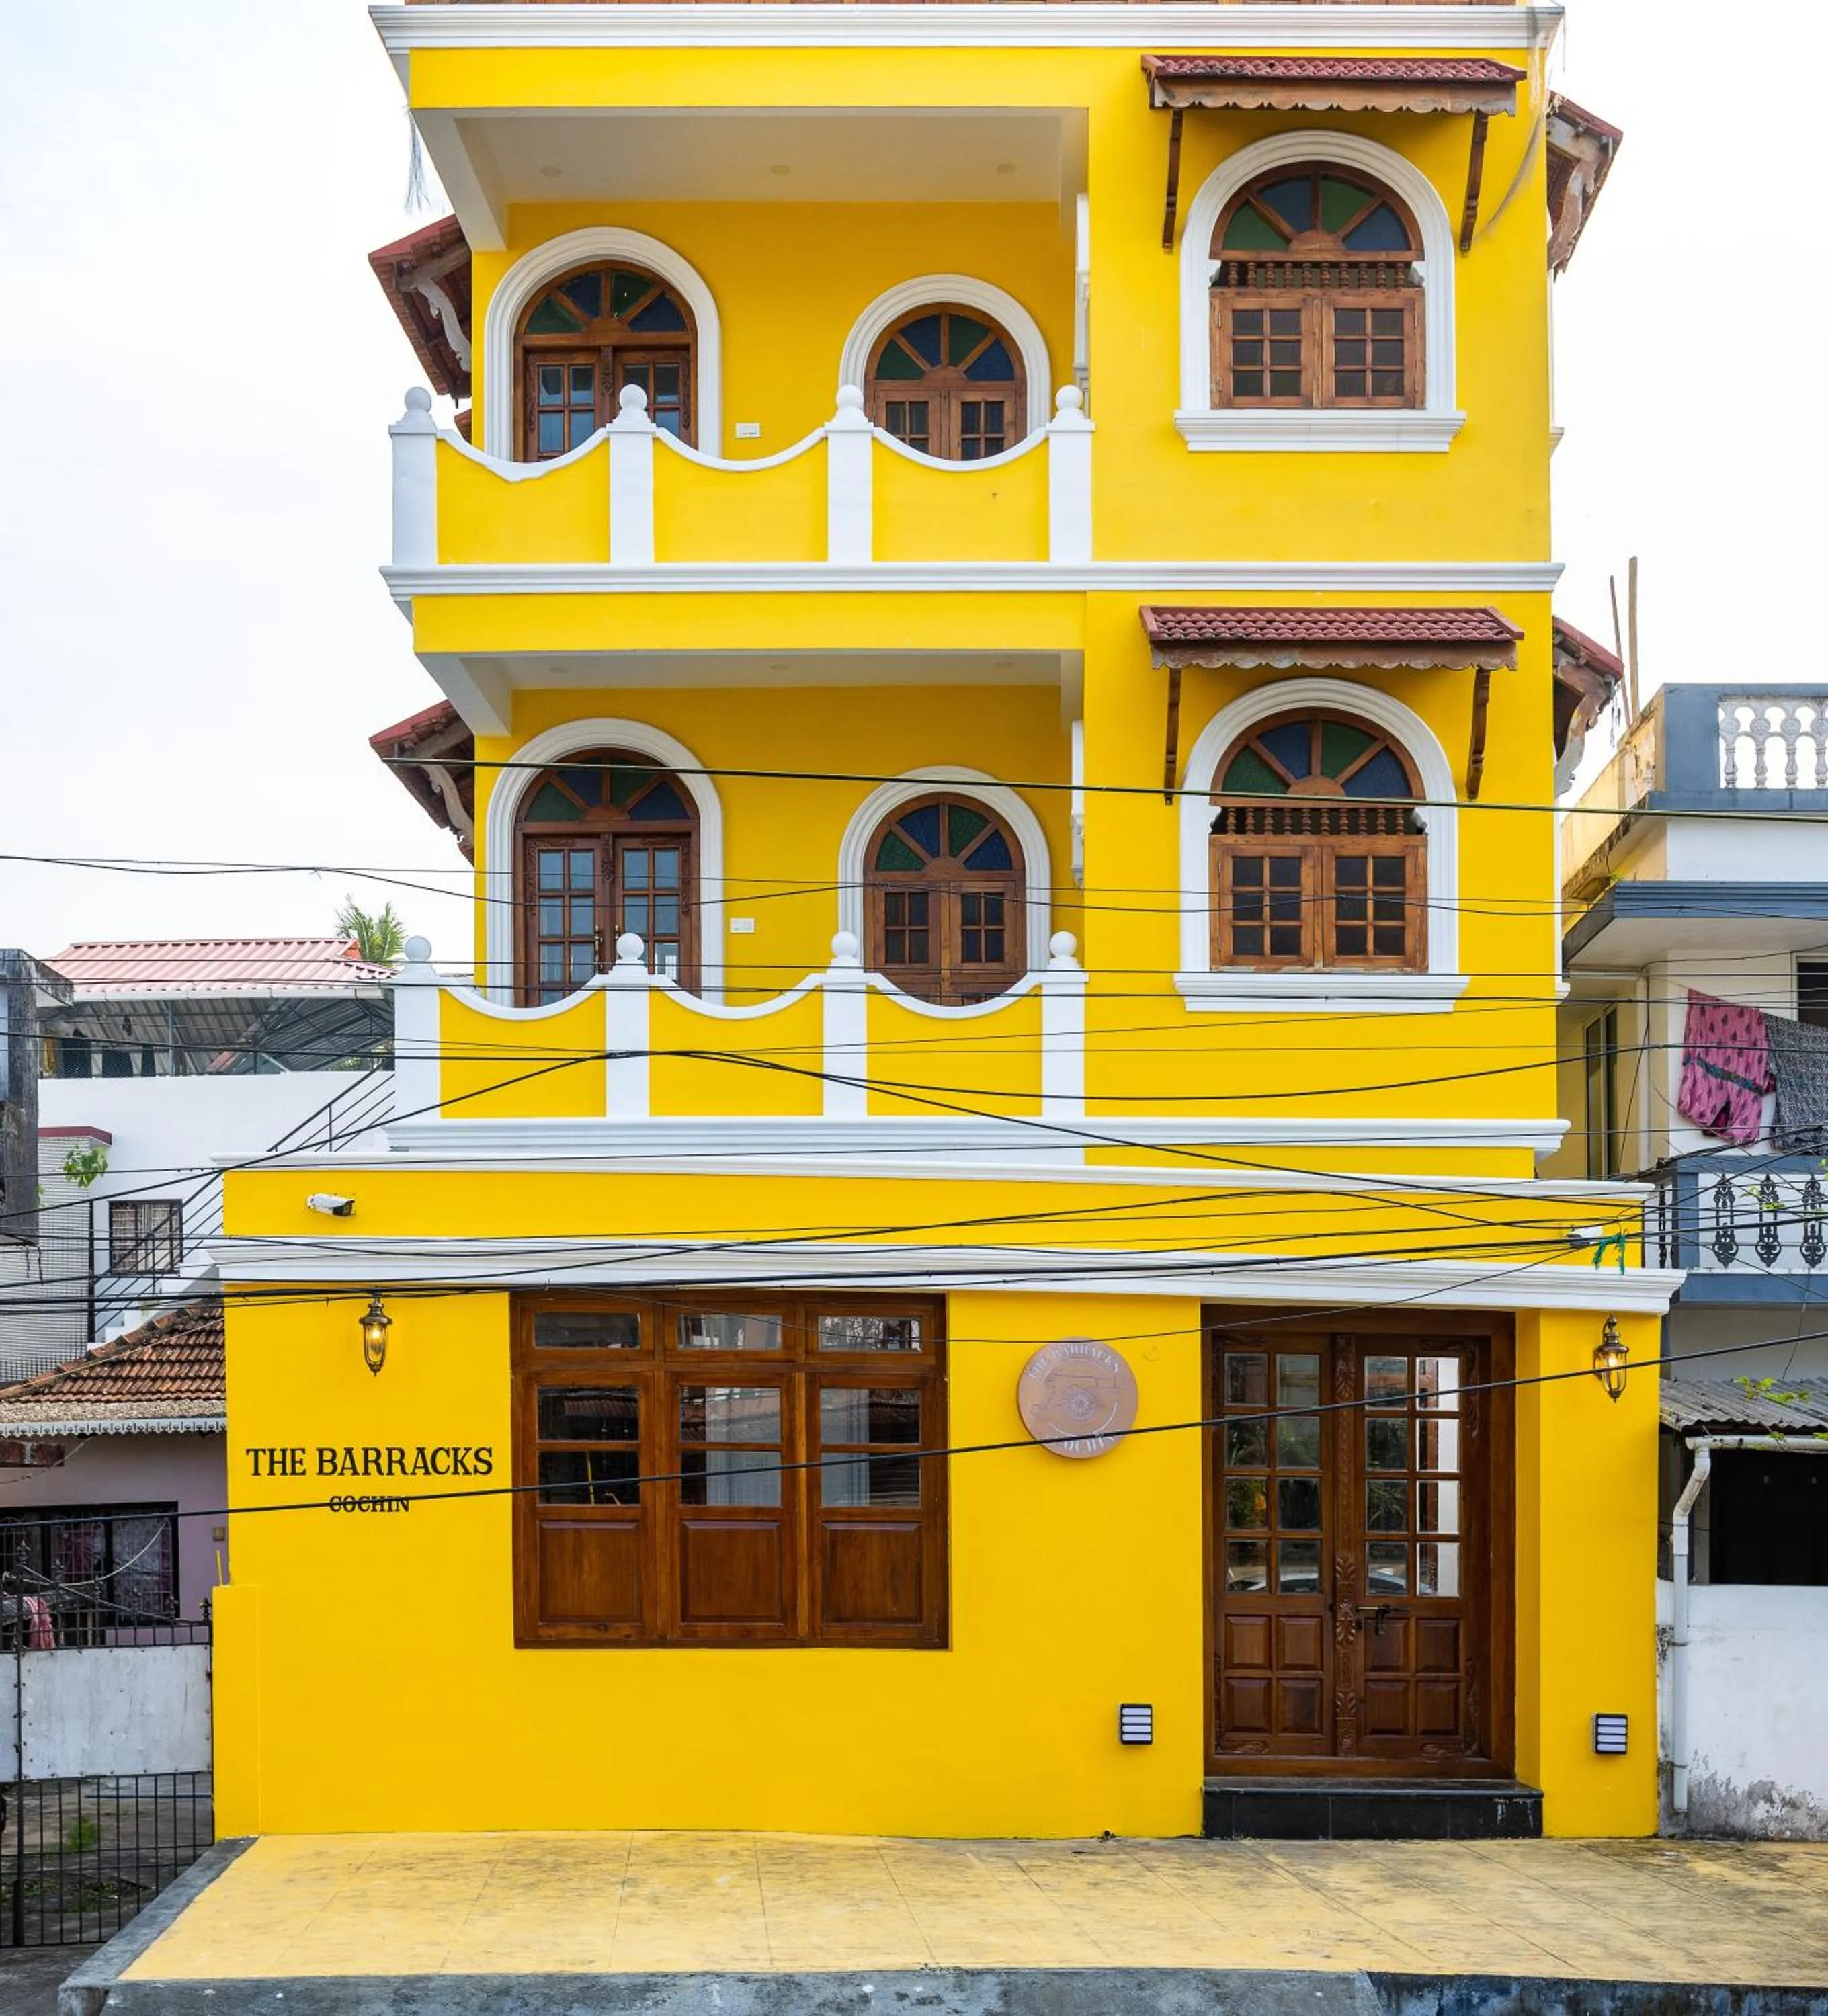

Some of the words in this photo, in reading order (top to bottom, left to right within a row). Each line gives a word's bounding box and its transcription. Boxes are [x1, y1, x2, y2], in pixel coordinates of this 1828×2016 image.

[246, 1447, 306, 1476] THE
[317, 1447, 493, 1476] BARRACKS
[329, 1495, 409, 1513] COCHIN
